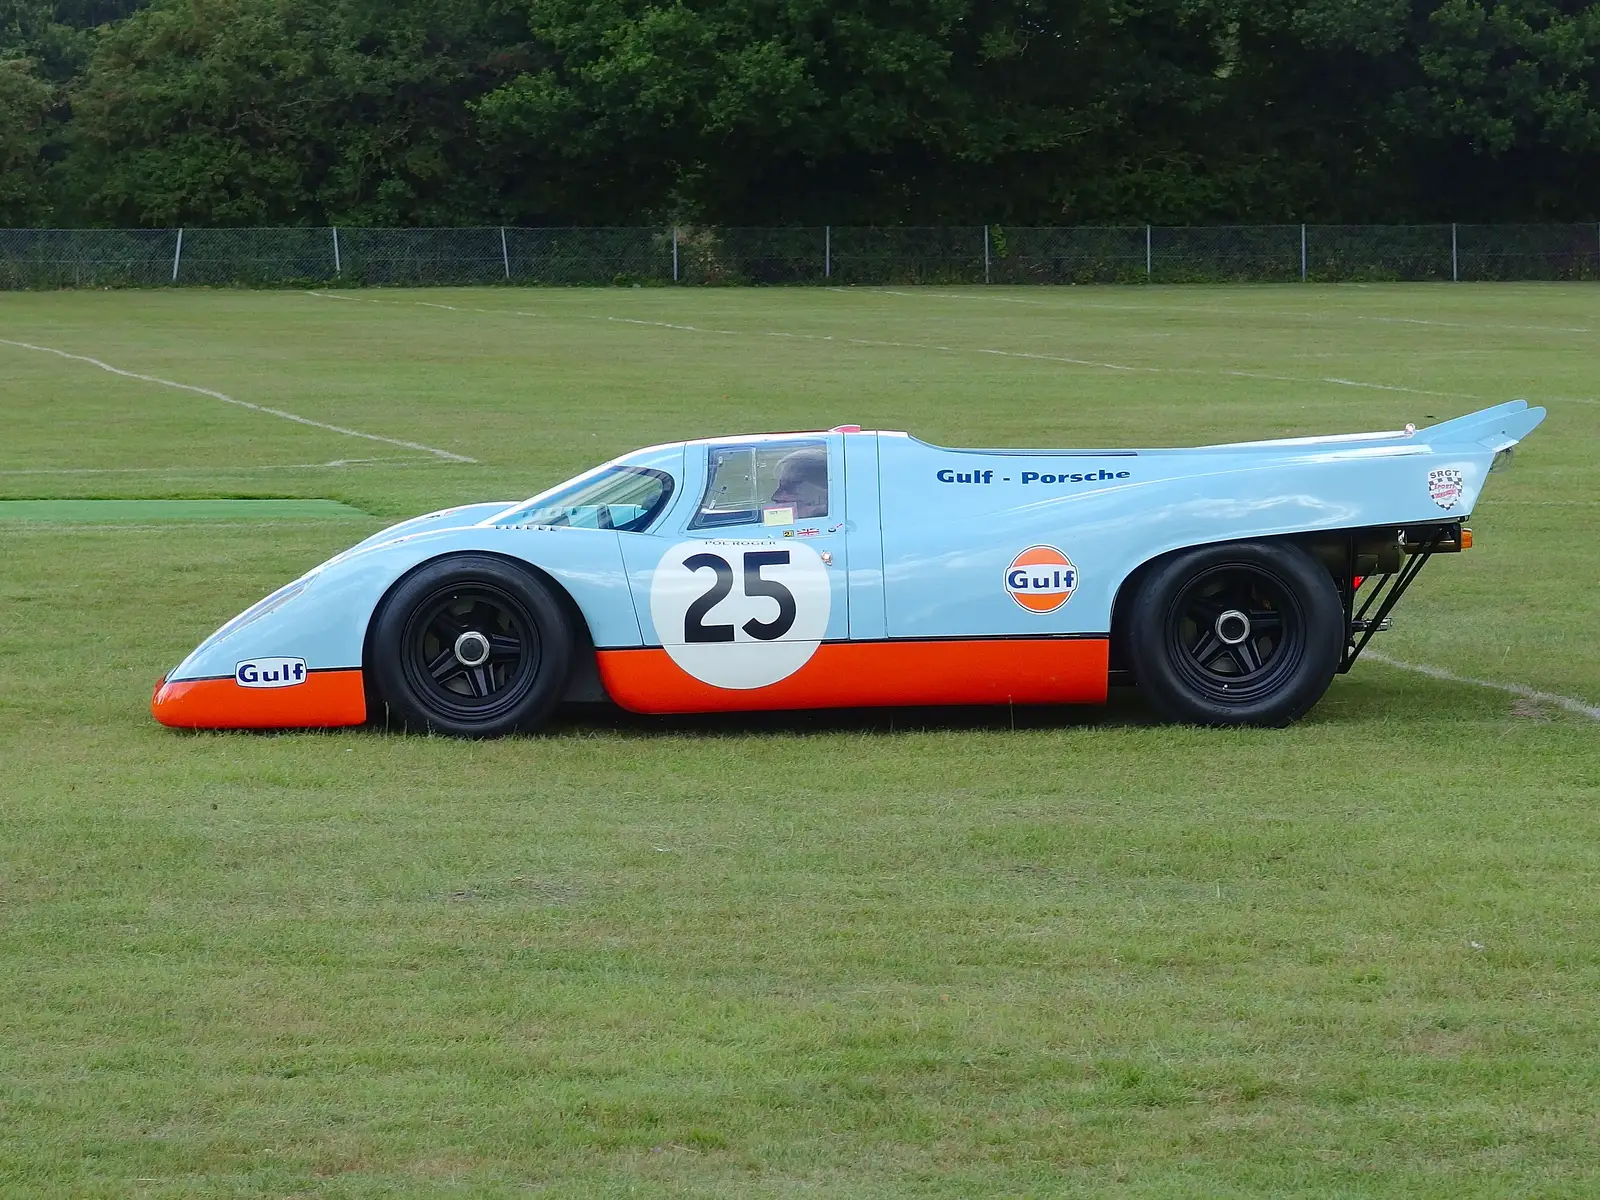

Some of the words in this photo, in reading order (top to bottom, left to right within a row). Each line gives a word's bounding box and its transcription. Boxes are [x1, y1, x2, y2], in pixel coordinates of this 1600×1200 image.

[936, 469, 993, 484] Gulf
[1021, 470, 1131, 484] Porsche
[1430, 469, 1460, 479] SRGT
[1008, 569, 1075, 589] Gulf
[682, 550, 797, 643] 25
[238, 663, 304, 683] Gulf
